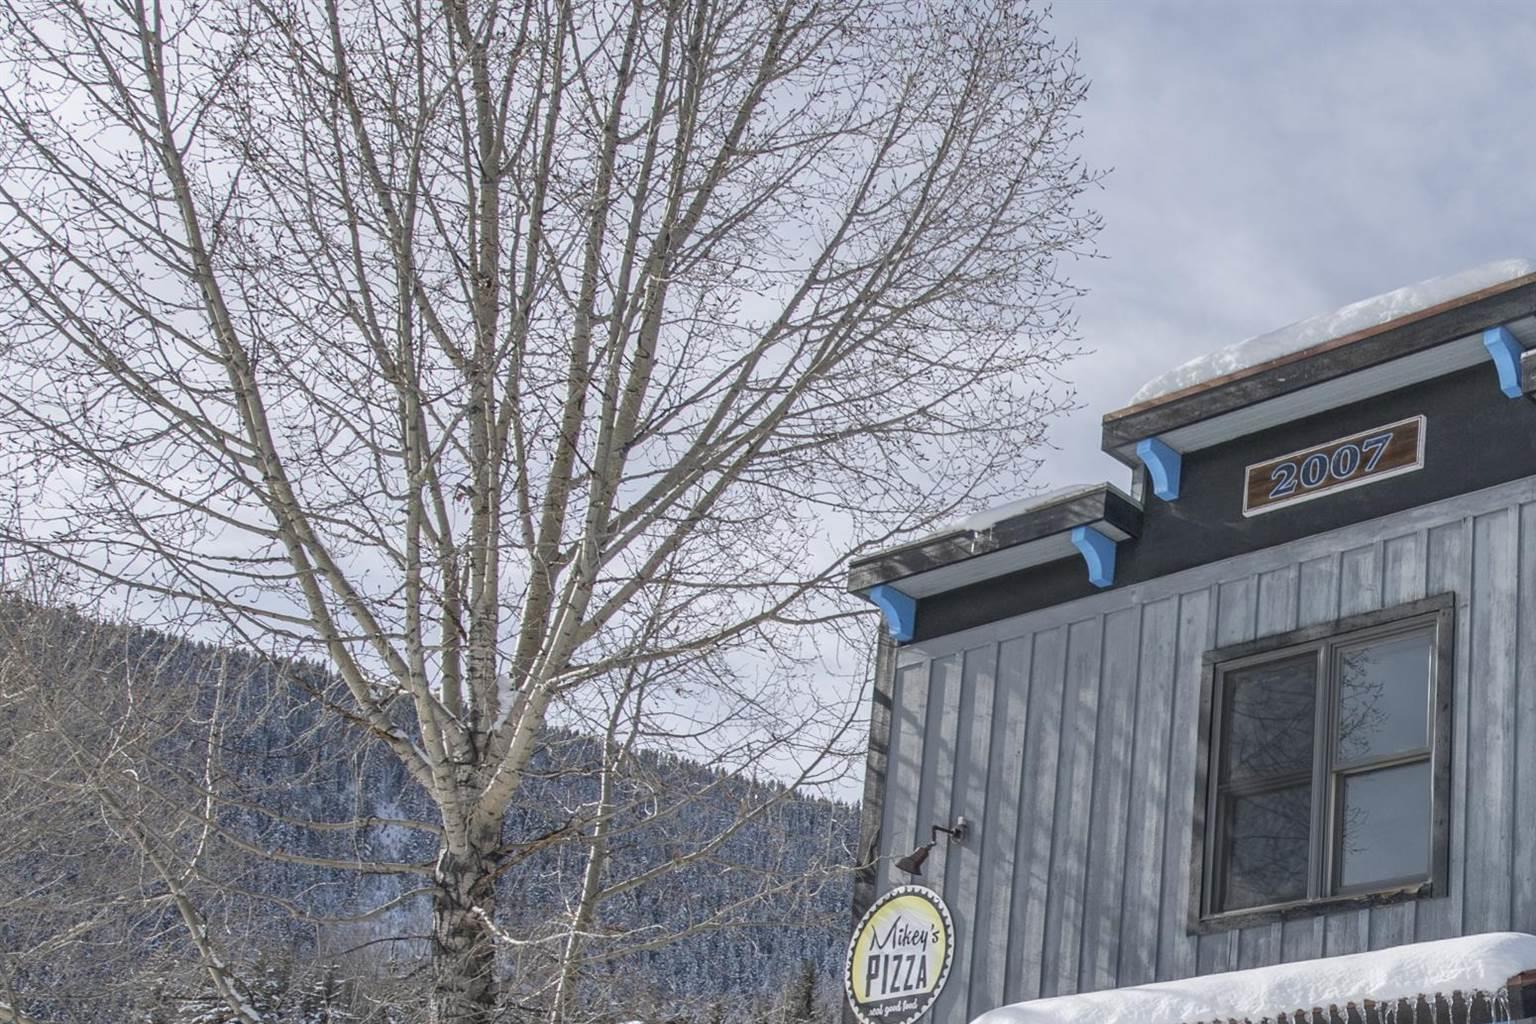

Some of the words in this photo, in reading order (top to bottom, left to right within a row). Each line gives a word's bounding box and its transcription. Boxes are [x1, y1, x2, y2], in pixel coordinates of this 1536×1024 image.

[1269, 432, 1394, 499] 2007
[869, 915, 940, 952] Mikey's
[865, 954, 927, 997] PIZZA
[884, 1000, 902, 1017] good
